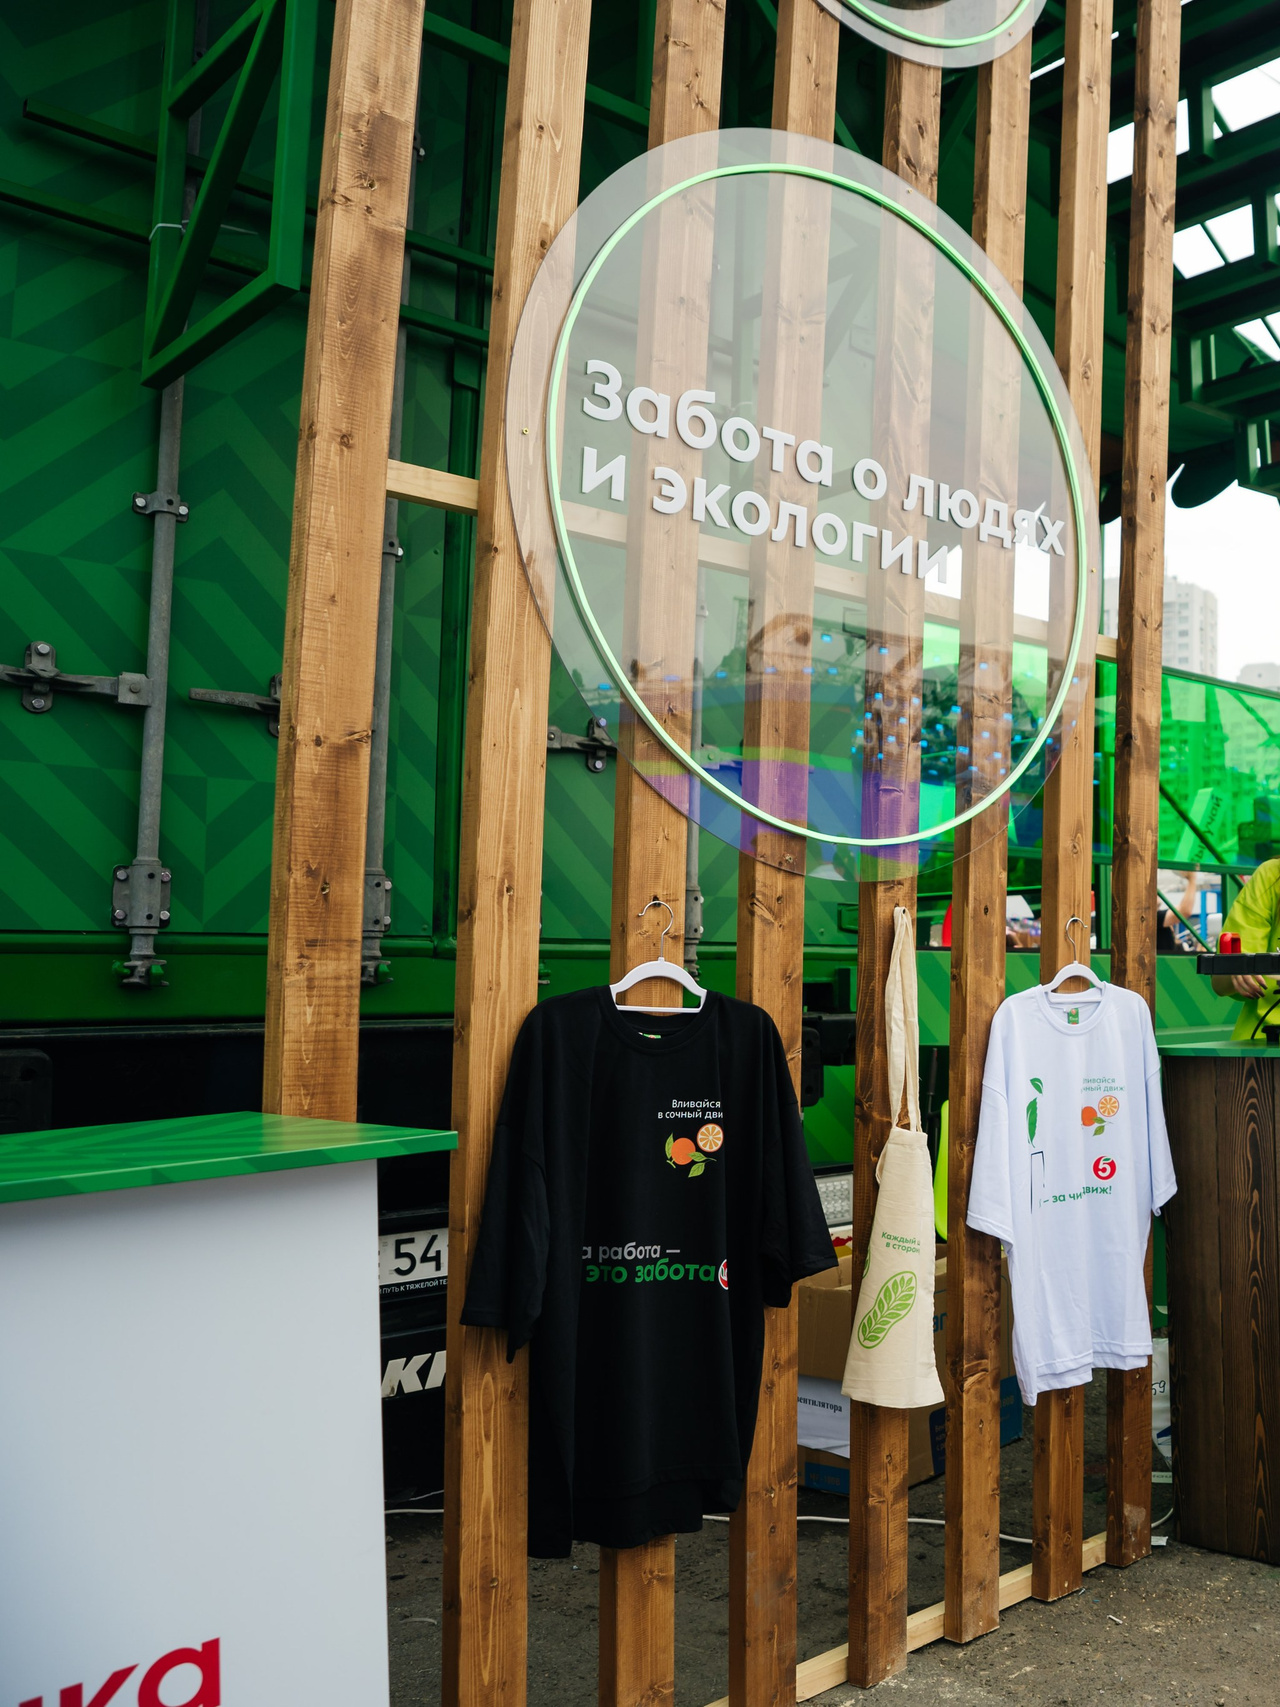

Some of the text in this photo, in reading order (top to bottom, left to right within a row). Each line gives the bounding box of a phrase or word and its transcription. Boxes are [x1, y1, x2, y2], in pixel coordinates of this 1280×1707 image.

[582, 359, 1066, 557] Забота о людях
[581, 446, 949, 584] и экологии
[672, 1099, 721, 1109] Вливайся
[665, 1109, 702, 1119] сочный
[1052, 1194, 1066, 1203] за
[881, 1231, 916, 1245] Каждый
[394, 1234, 442, 1276] 54
[599, 1241, 661, 1263] работа
[586, 1264, 628, 1283] это
[635, 1257, 716, 1283] забота
[382, 1285, 400, 1295] ПУТЬ
[400, 1284, 405, 1292] К
[406, 1278, 439, 1291] ТЯЖЕЛОЙ
